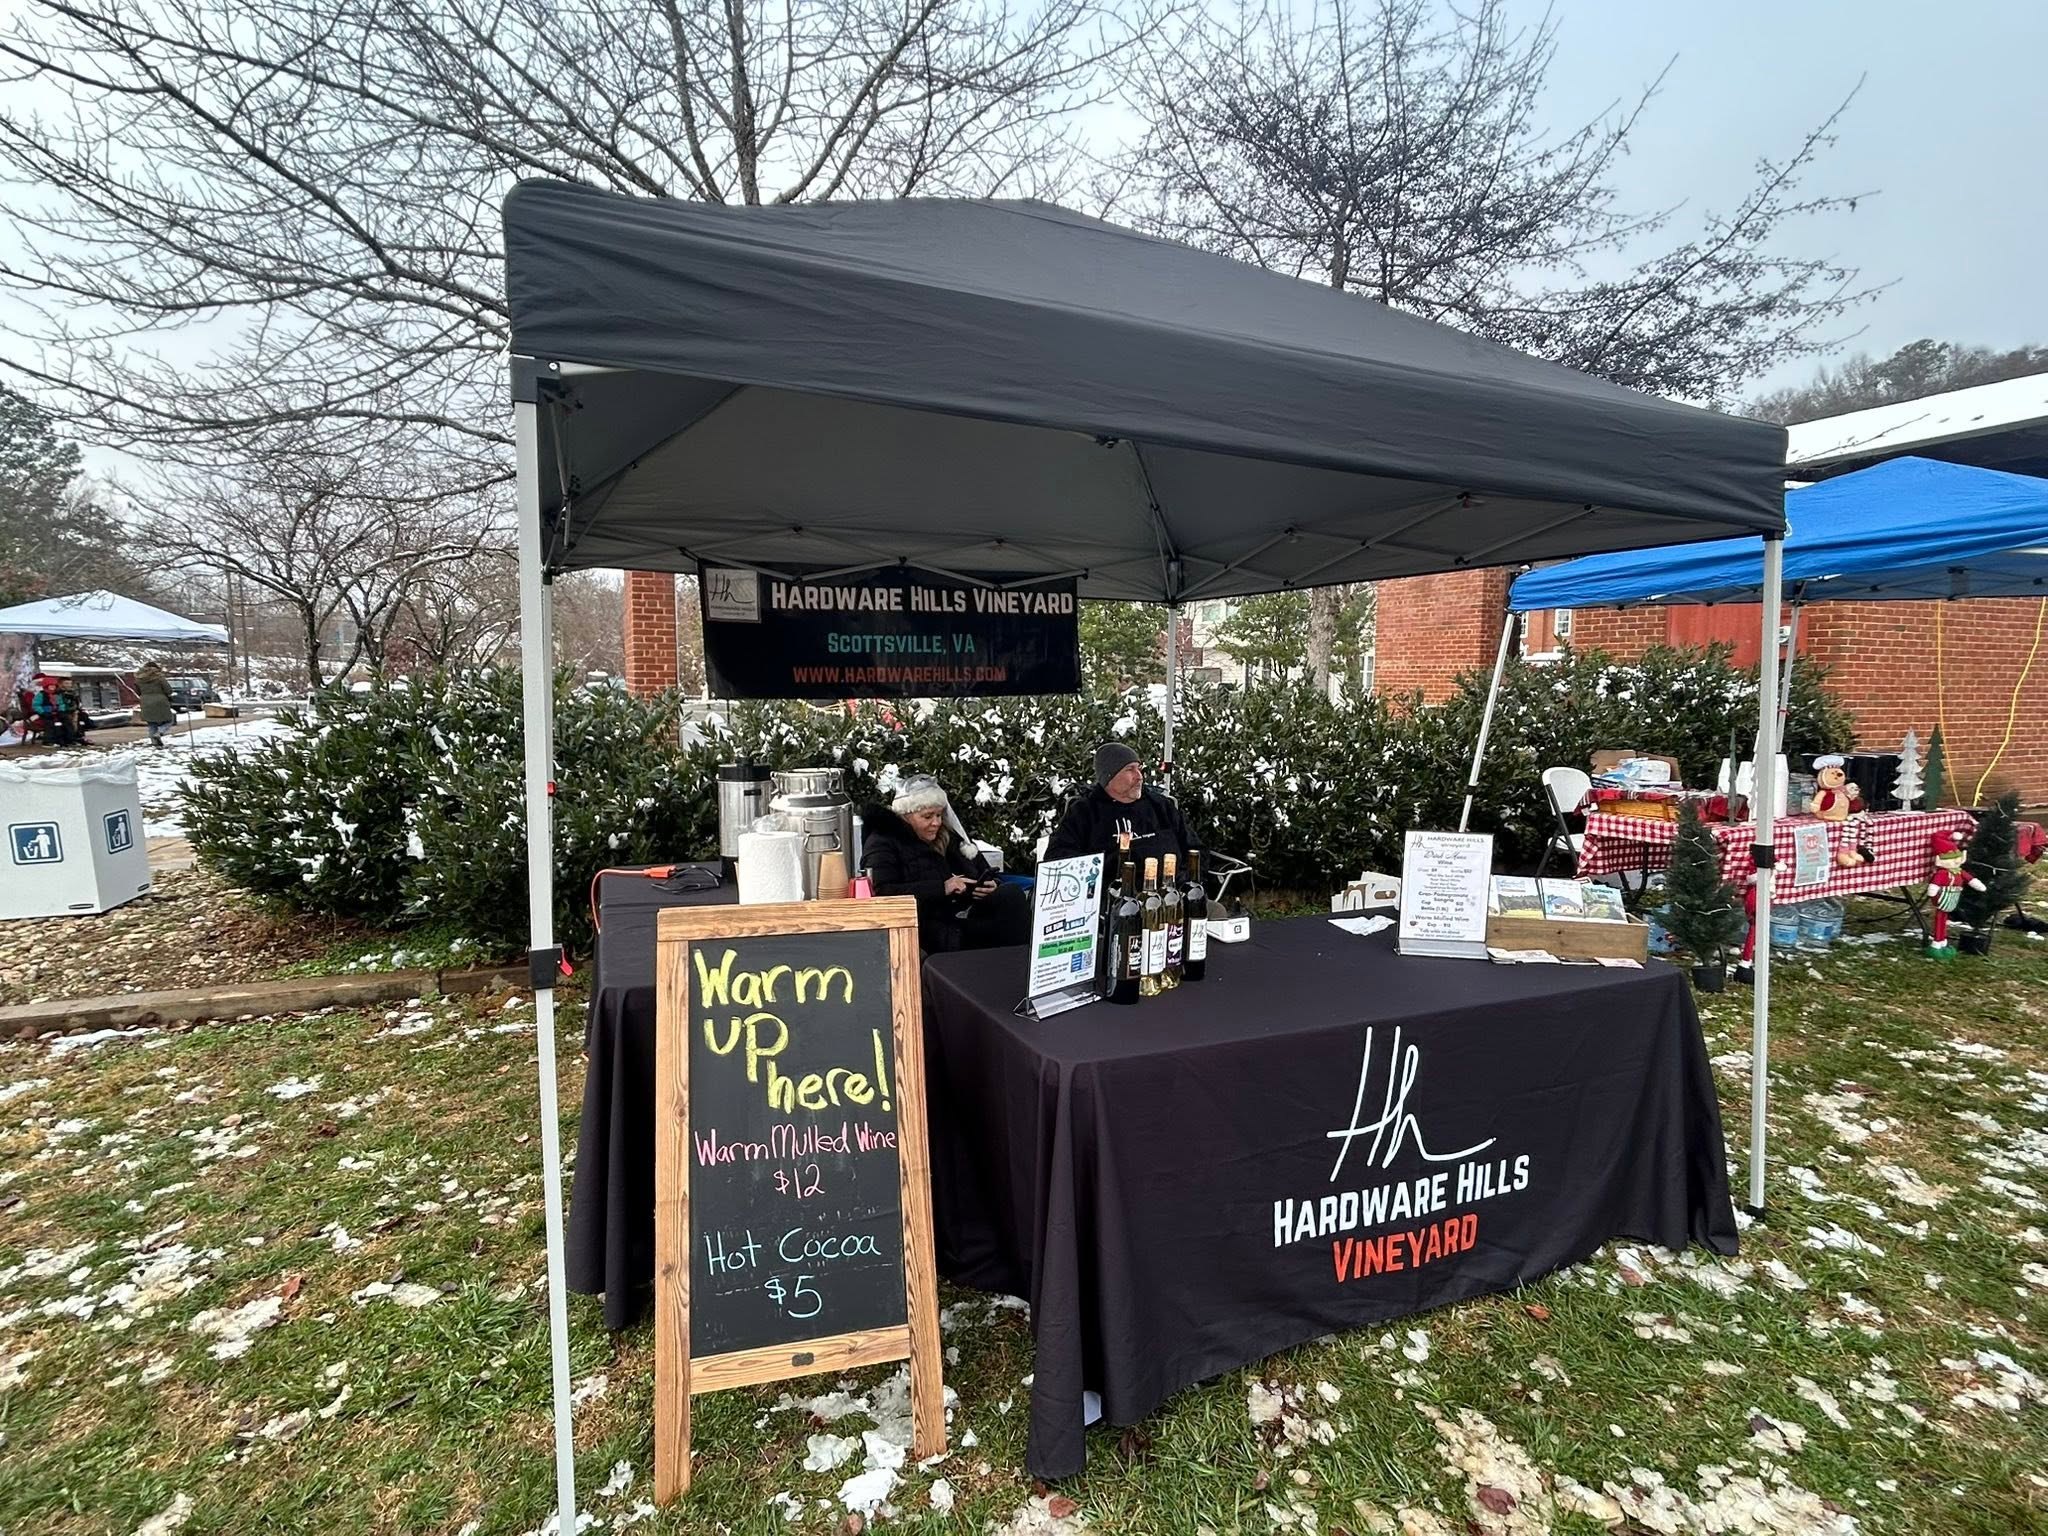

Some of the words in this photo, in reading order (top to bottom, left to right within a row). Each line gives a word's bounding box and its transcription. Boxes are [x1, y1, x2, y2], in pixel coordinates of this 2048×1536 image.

[771, 581, 904, 612] HARDWARE
[911, 586, 967, 614] HILLS
[973, 588, 1074, 615] VINEYARD
[827, 632, 947, 656] SCOTTSVILLE,
[952, 633, 976, 654] VA
[793, 666, 1007, 684] WWW.HARDWAREHILLS.COM
[694, 948, 854, 1009] Warm
[767, 1027, 891, 1114] here!
[694, 1129, 769, 1167] Warm
[770, 1122, 849, 1160] Mulled
[854, 1121, 897, 1151] Wine
[773, 1164, 826, 1199] $12
[1274, 1172, 1449, 1248] HARDWARE
[1456, 1154, 1530, 1205] HILLS
[705, 1230, 762, 1275] Hot
[778, 1227, 882, 1263] Cocoa
[1332, 1213, 1479, 1283] VINEYARD
[763, 1275, 823, 1318] $5
